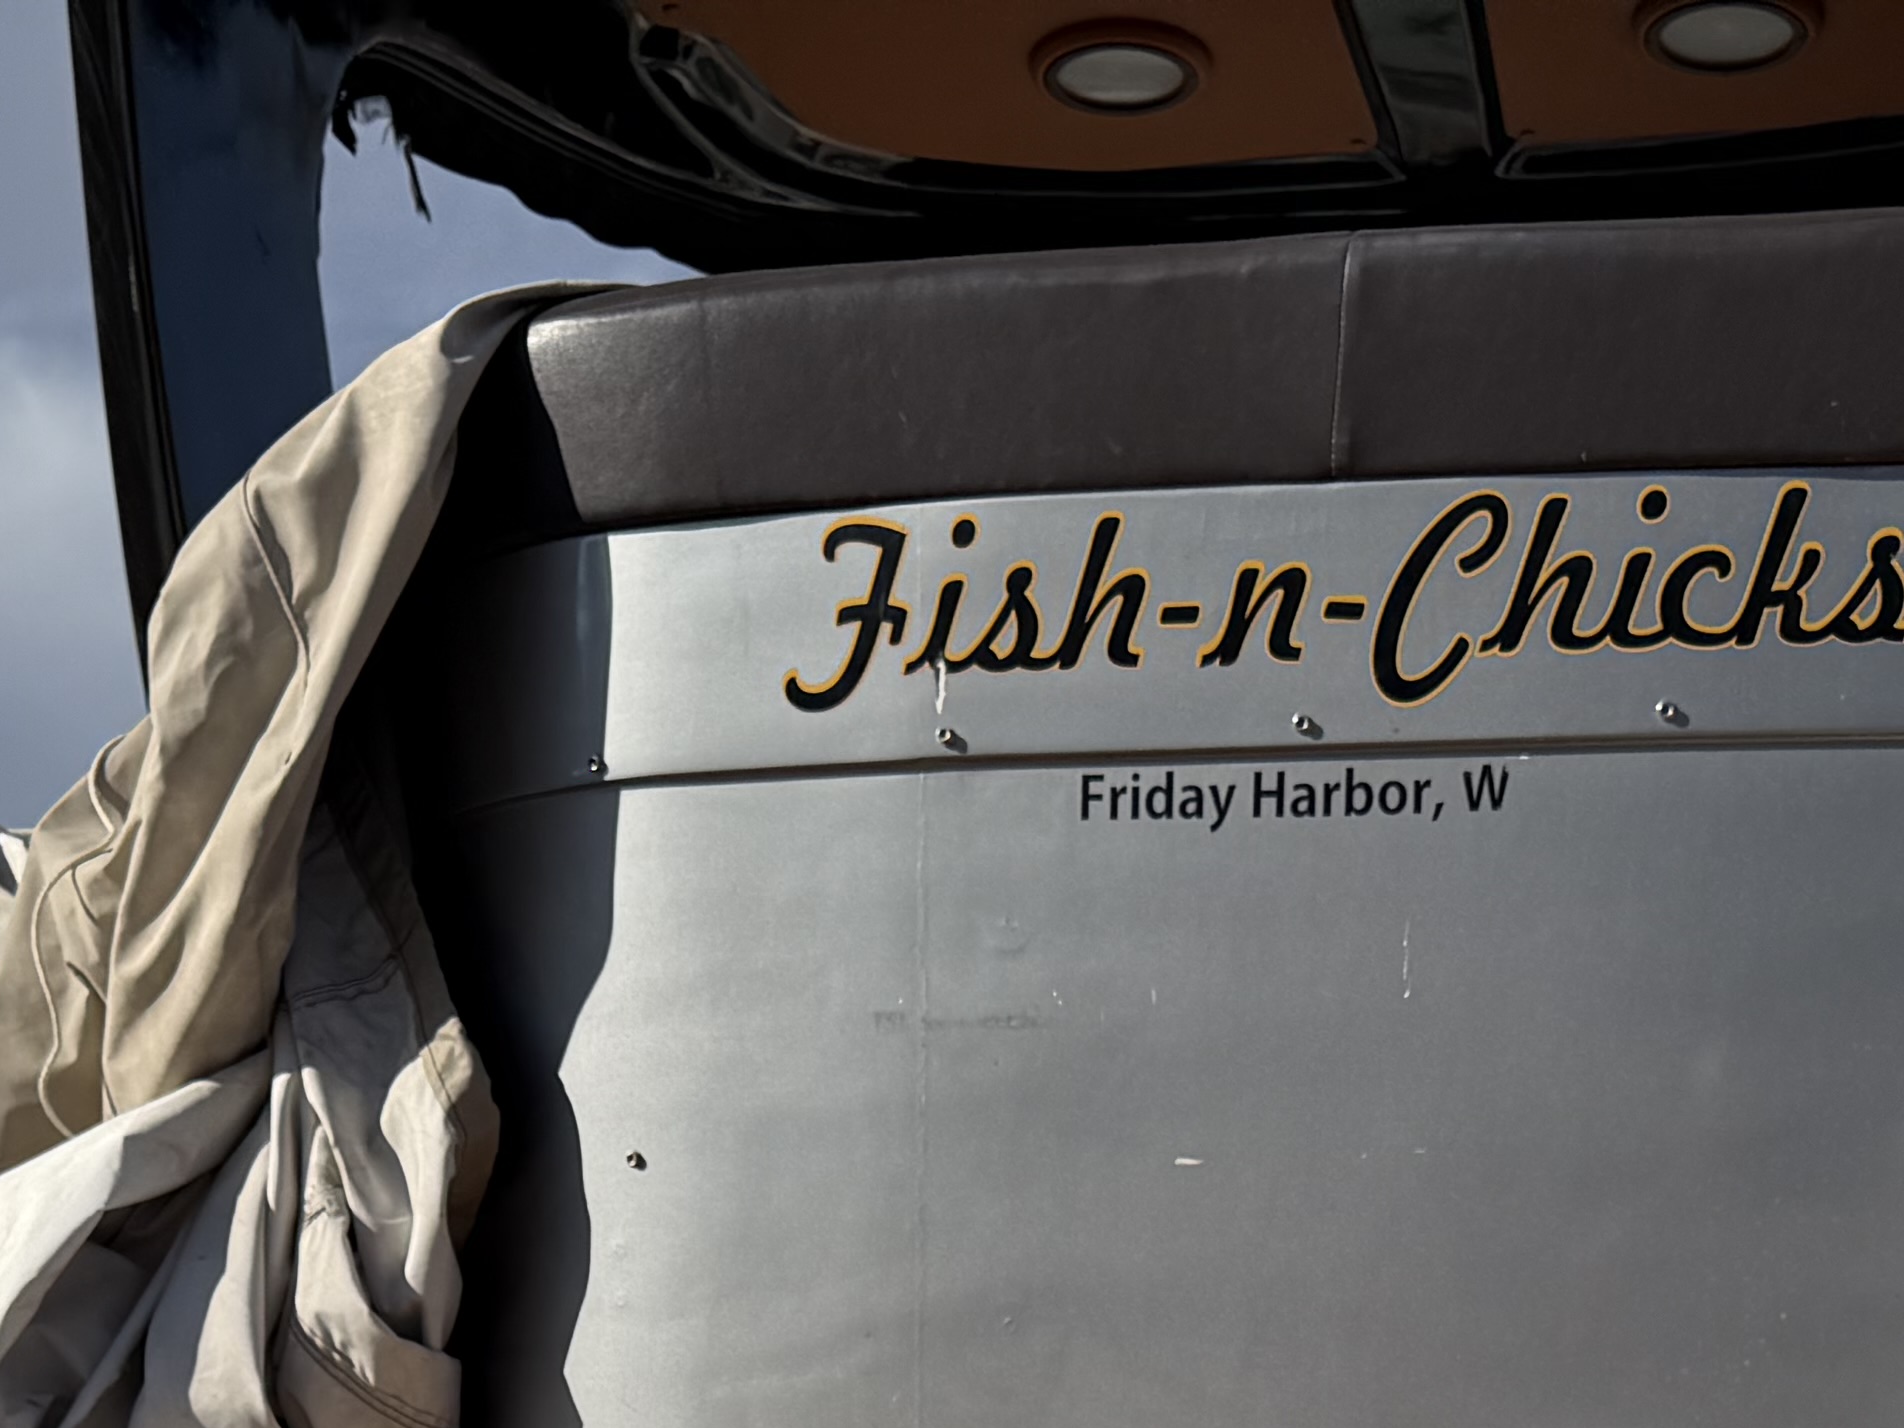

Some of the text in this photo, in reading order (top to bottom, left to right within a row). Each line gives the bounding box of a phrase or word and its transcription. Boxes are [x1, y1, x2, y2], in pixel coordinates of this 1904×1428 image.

[1079, 763, 1510, 833] Friday Harbor, W
